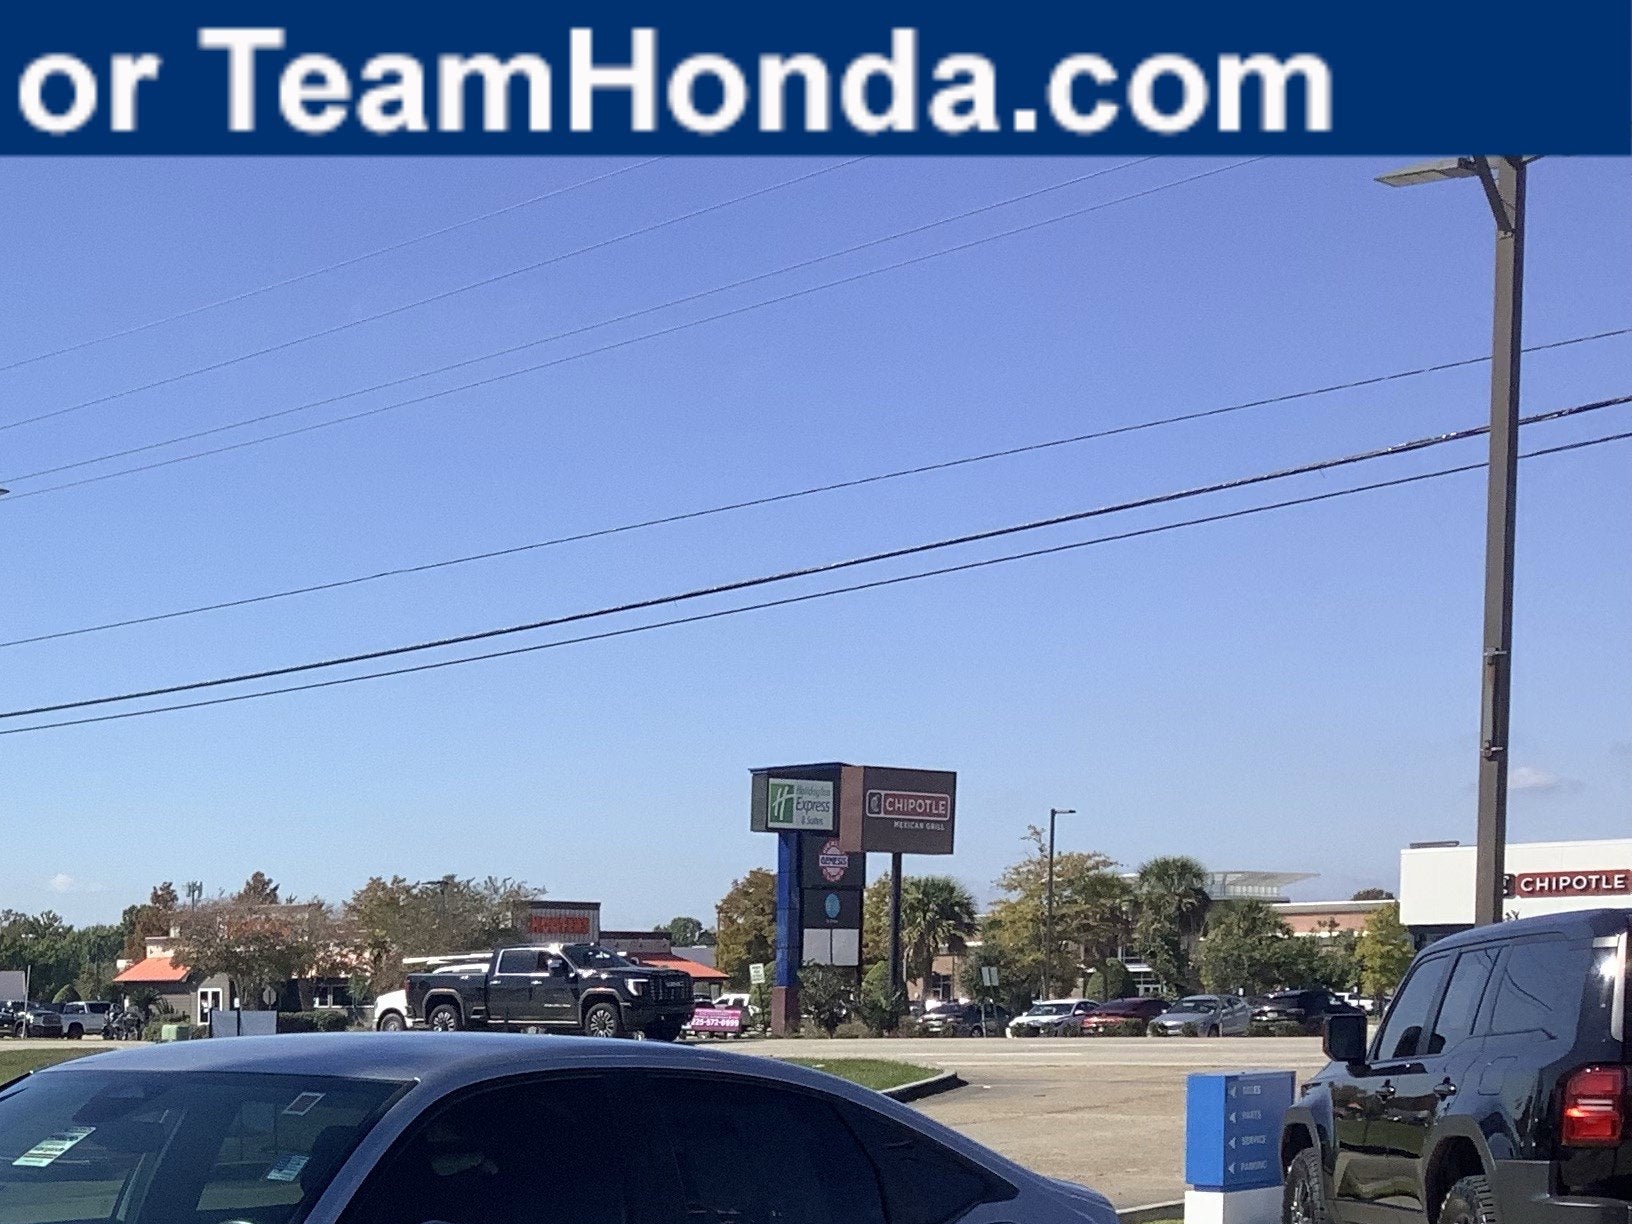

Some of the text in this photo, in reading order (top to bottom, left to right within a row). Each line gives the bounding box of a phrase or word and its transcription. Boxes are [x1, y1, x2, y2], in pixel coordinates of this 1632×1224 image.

[796, 797, 830, 815] Express
[885, 797, 946, 814] CHIPOTLE
[893, 821, 924, 830] MEXICAN
[1520, 874, 1626, 892] CHIPOTLE
